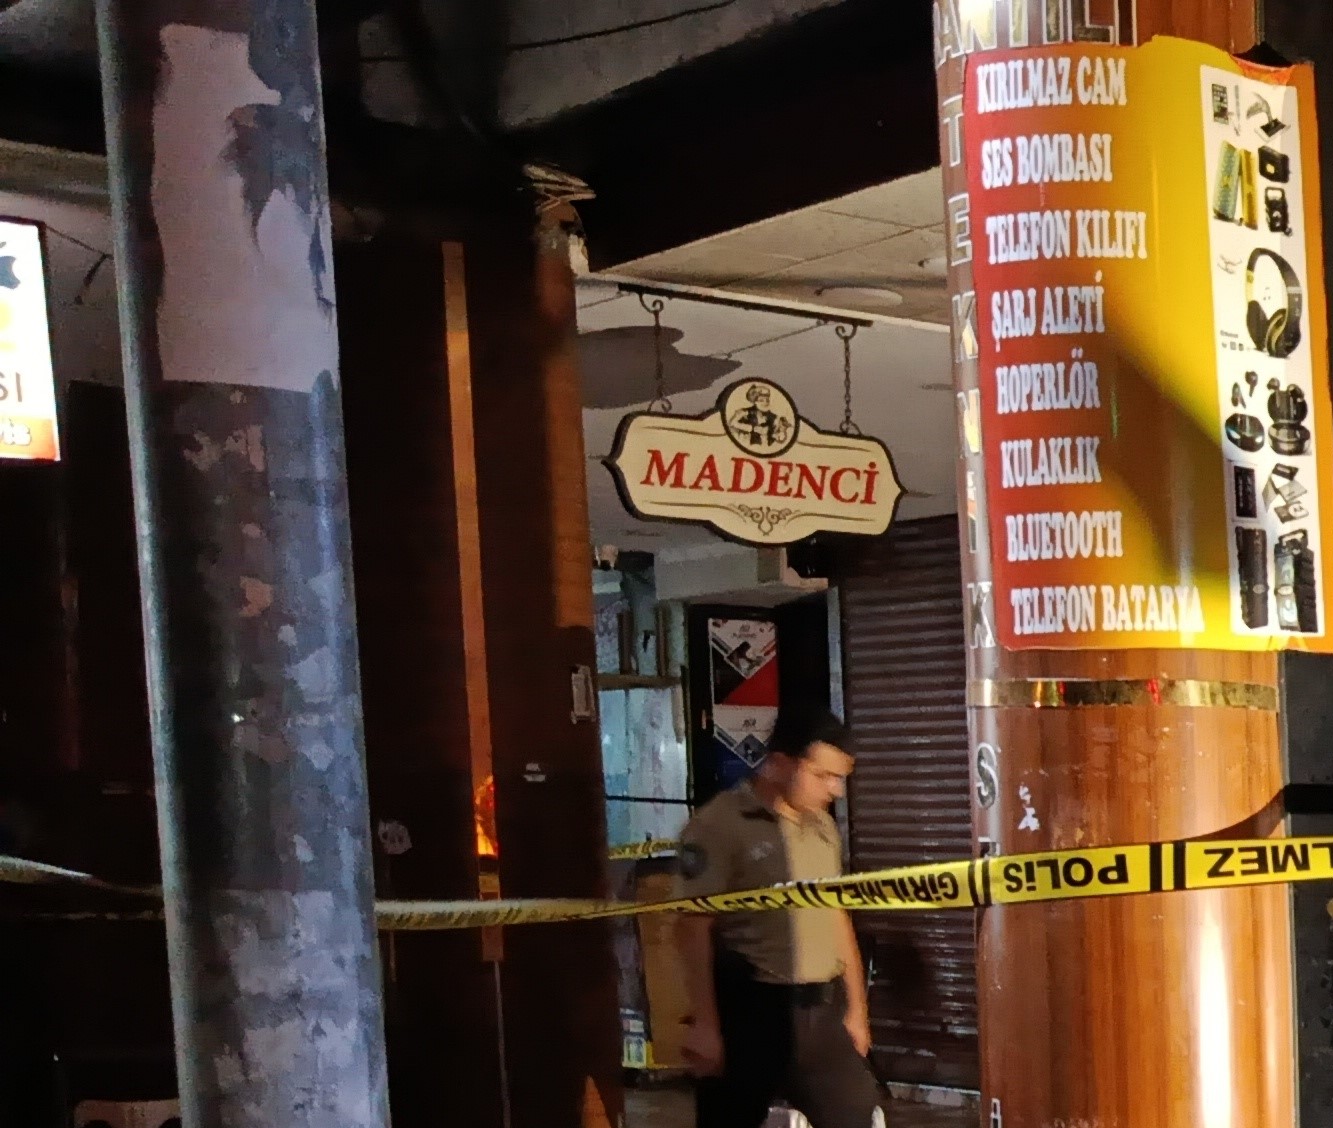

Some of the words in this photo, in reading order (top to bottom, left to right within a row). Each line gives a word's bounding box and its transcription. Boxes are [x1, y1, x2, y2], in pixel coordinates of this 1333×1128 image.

[976, 56, 1073, 114] KIRILMAZ
[1076, 55, 1128, 106] CAM
[981, 138, 1012, 190] SES
[1016, 133, 1113, 185] BOMBASI
[985, 209, 1072, 265] TELEFON
[1041, 270, 1106, 334] ALETİ
[995, 347, 1101, 415] HOPERLÖR
[640, 449, 880, 506] MADENCİ
[1000, 436, 1102, 489] KULAKLIK
[1006, 510, 1124, 562] BLUETOOTH
[1011, 585, 1096, 635] TELEFON
[1100, 584, 1205, 633] BATARYA
